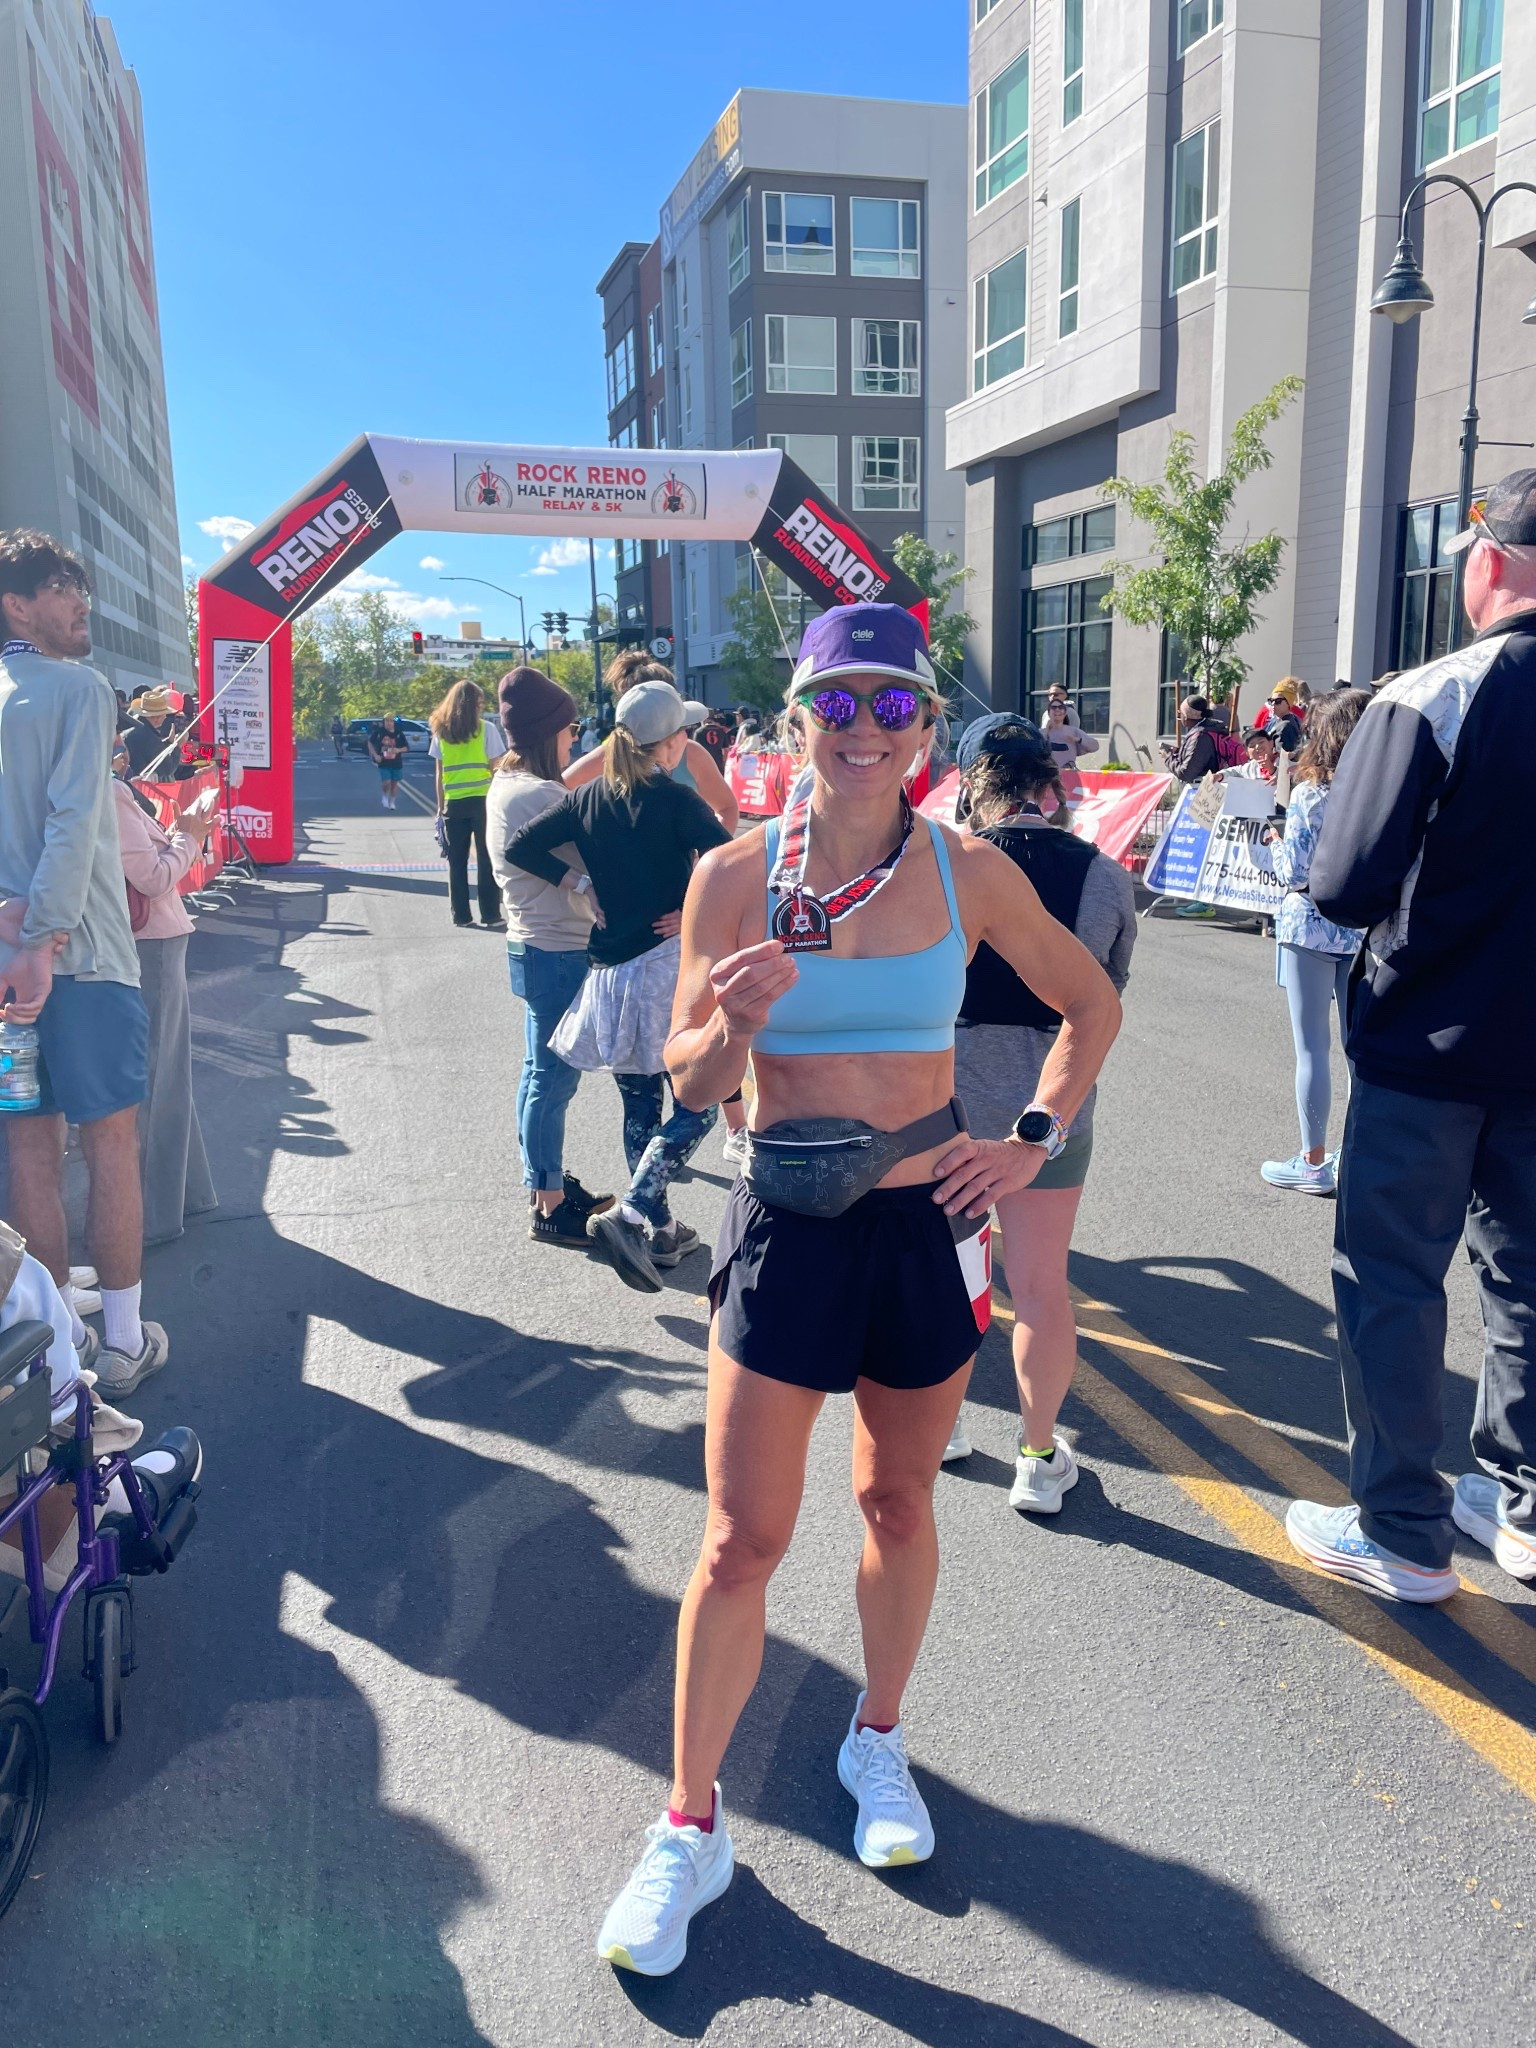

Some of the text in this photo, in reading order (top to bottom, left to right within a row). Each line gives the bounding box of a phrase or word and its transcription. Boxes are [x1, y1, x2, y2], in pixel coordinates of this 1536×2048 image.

[516, 463, 647, 486] ROCK RENO
[517, 484, 646, 501] HALF MARATHON
[343, 488, 382, 530] RACES
[543, 500, 623, 512] RELAY & 5K
[256, 499, 360, 592] RENO
[782, 504, 875, 595] RENO
[281, 542, 347, 603] RUNNING
[773, 527, 856, 605] RUNNING CO
[232, 665, 264, 674] baance
[243, 710, 258, 718] FOX
[706, 729, 719, 745] 6
[803, 932, 827, 941] RENO
